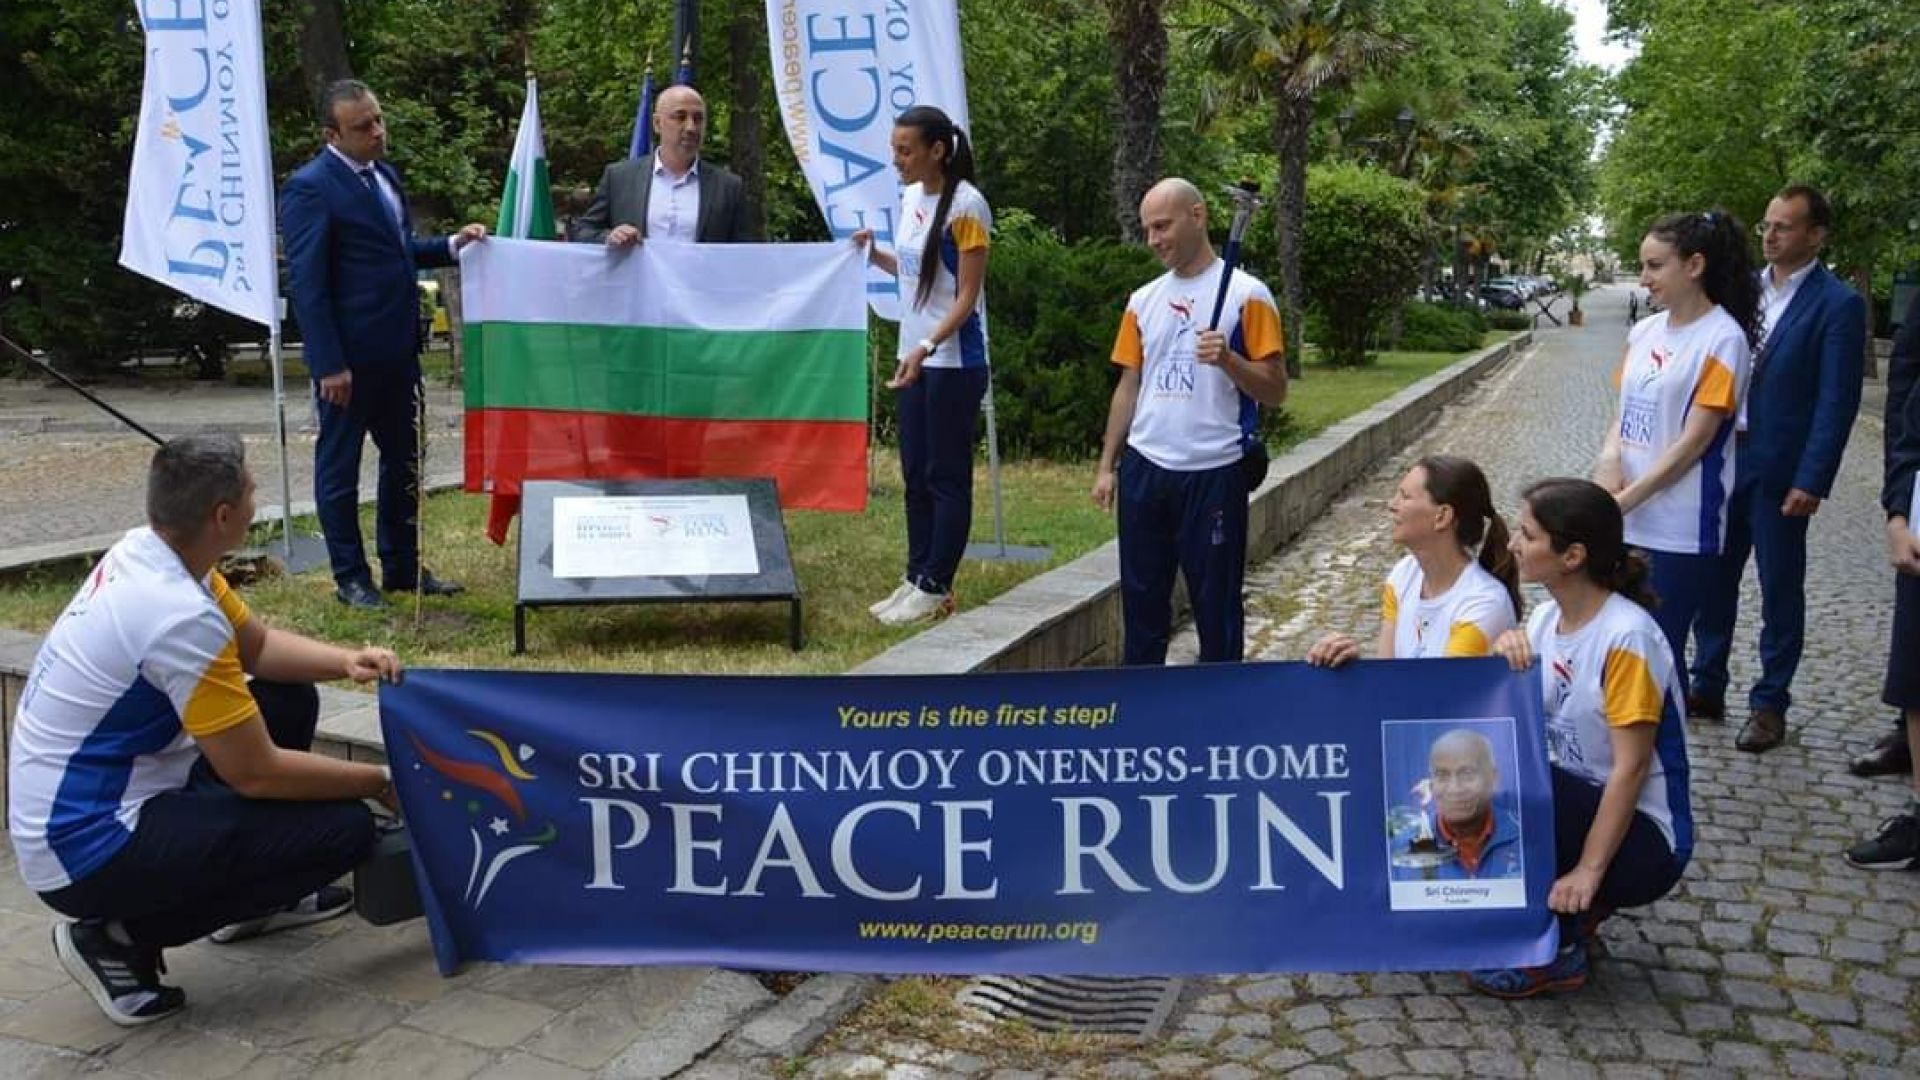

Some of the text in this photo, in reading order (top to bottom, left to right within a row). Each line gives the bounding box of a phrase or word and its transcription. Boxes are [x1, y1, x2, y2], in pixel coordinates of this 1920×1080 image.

[838, 702, 1118, 729] Yours is the first step!
[578, 744, 1350, 792] SRI CHINMOY ONENESS-HOME
[579, 791, 1351, 900] PEACE RUN
[859, 921, 1098, 944] www.peacerun.org
